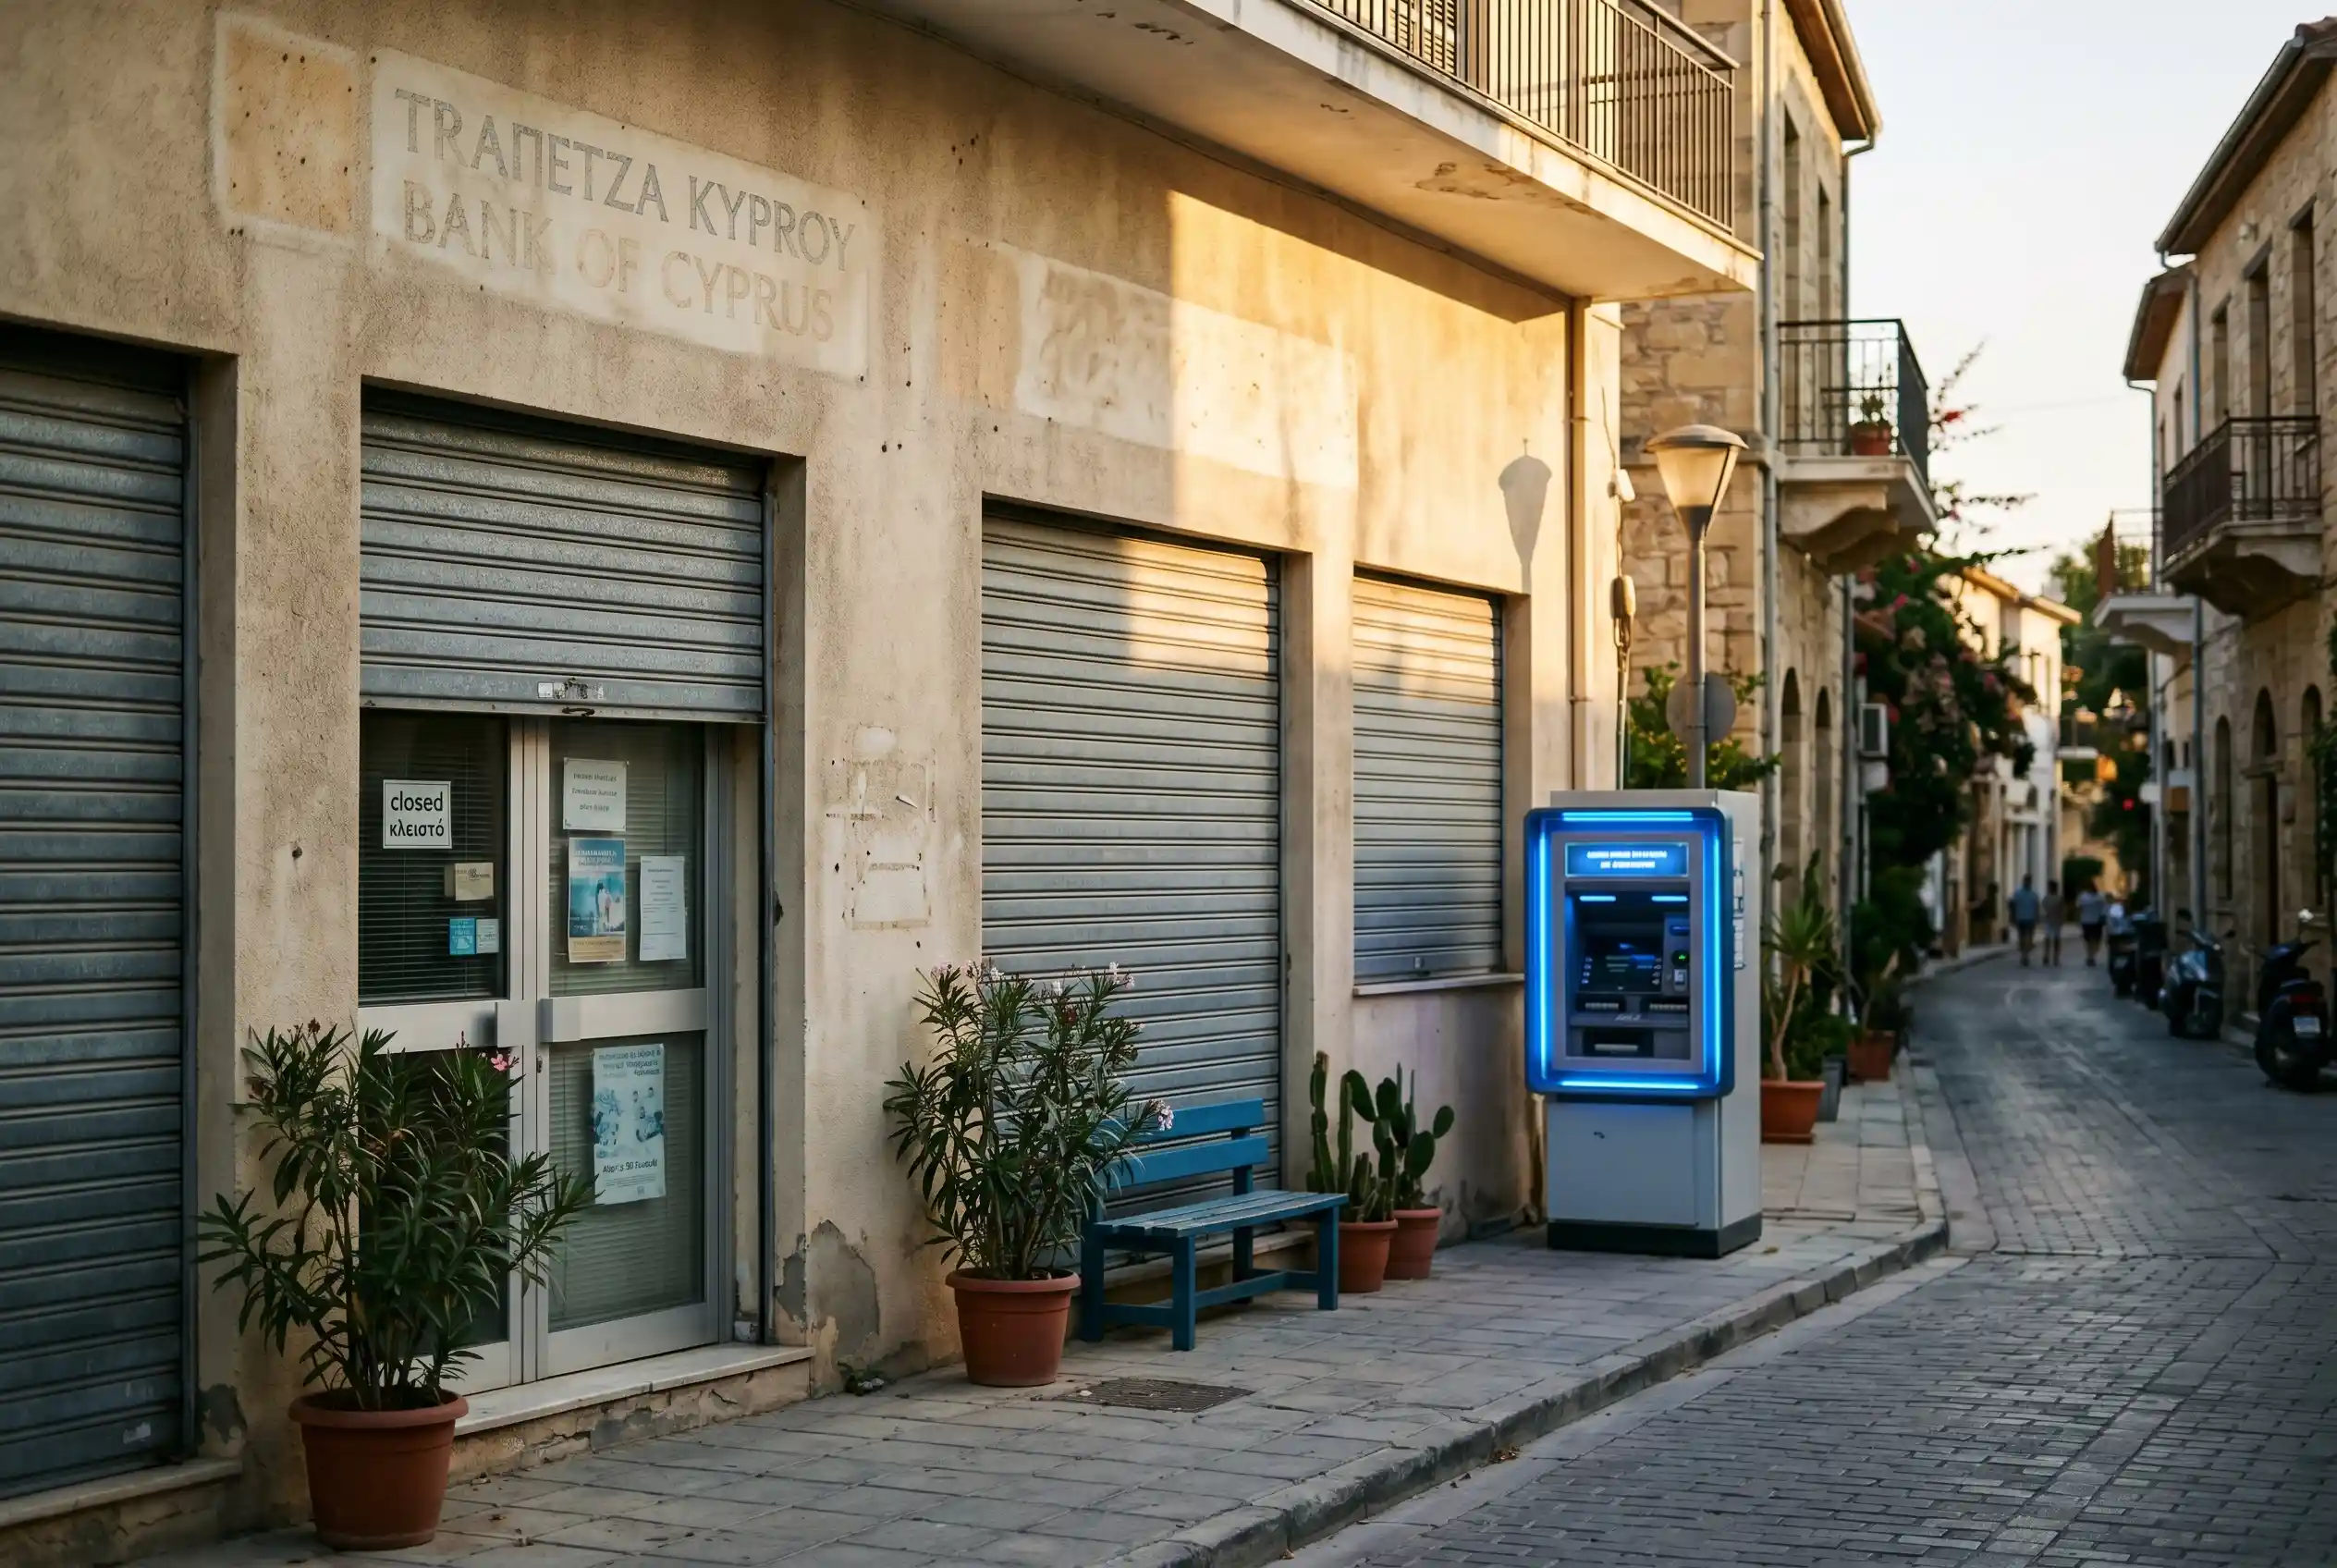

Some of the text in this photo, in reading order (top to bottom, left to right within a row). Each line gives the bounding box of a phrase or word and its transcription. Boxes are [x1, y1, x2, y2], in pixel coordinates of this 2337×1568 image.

[689, 176, 855, 271] KYPROY
[403, 179, 835, 342] BANK OF CYPRUS
[390, 818, 445, 837] κλειστό
[391, 790, 444, 812] closed
